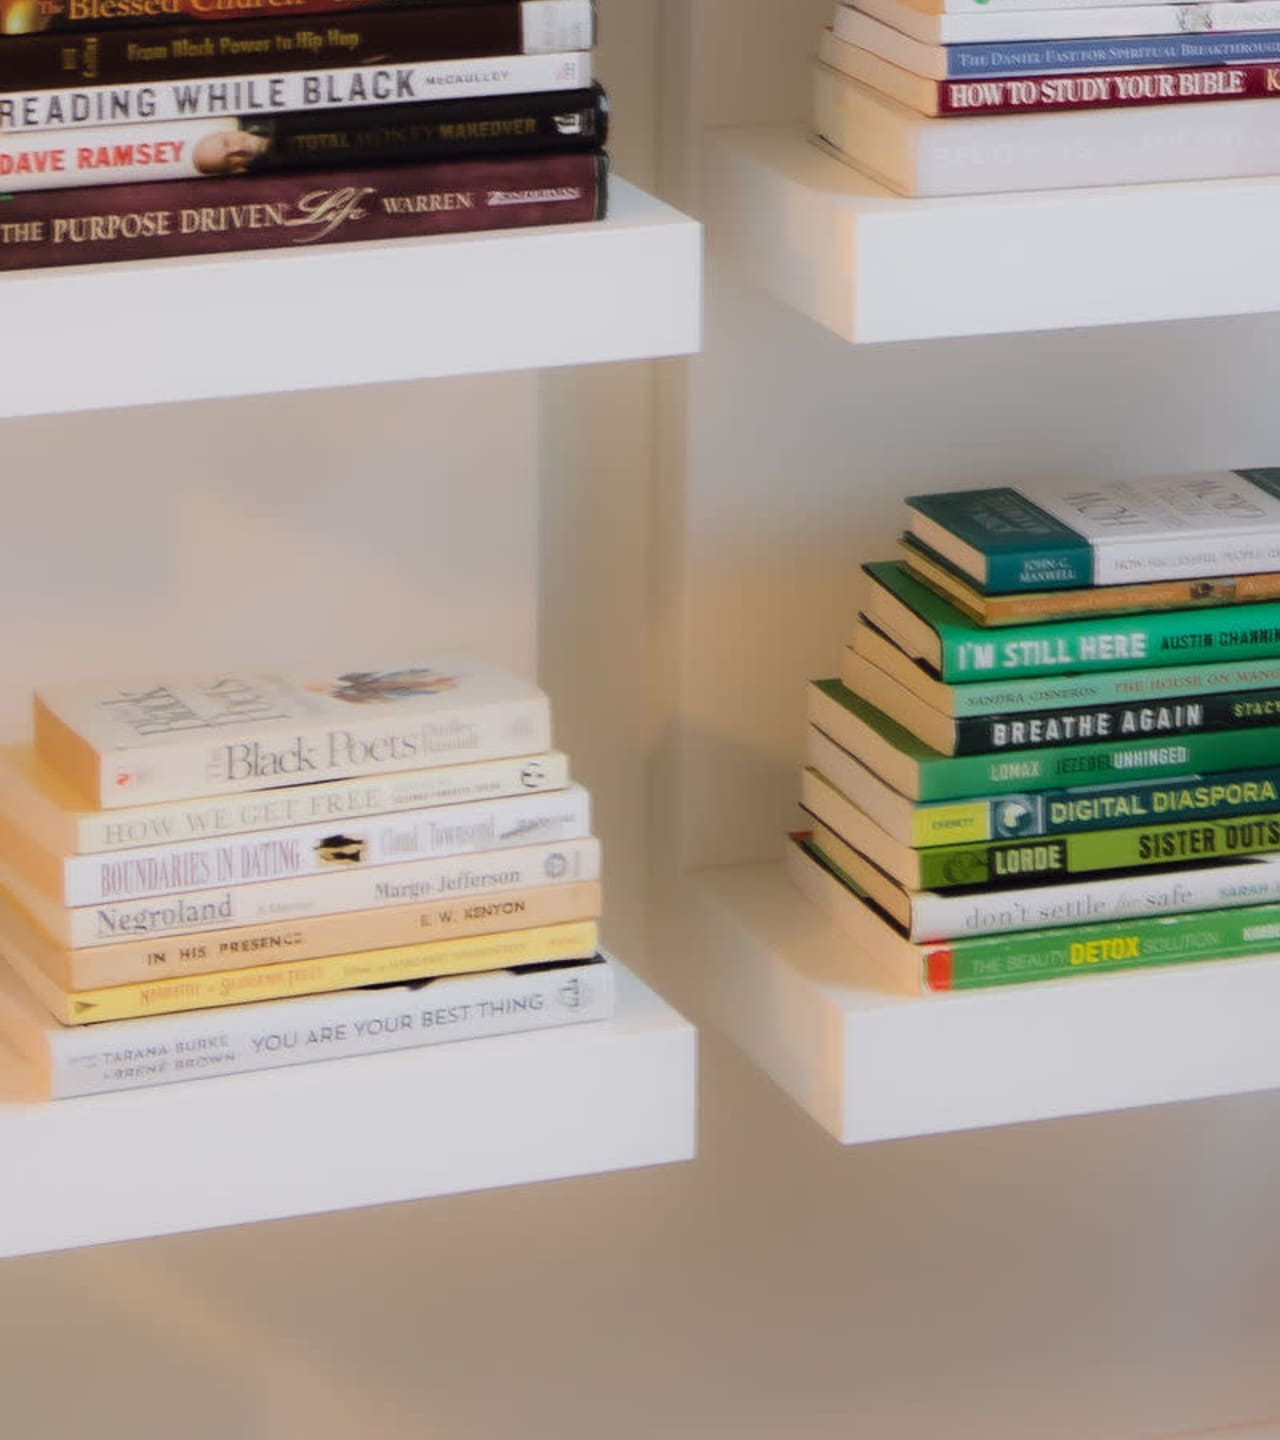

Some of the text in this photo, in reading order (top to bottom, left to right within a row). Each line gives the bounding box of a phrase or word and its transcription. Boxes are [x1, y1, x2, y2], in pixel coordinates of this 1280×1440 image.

[0, 69, 416, 128] READING WHILE BLACK
[950, 70, 1245, 108] HOW TO STUDY YOUR BIBLE
[0, 141, 185, 175] DAVE RAMSEY
[1, 186, 377, 244] THE PURPOSE DRIVEN Life
[381, 191, 474, 215] WARREN
[958, 633, 1147, 670] I'M STILL HERE
[1161, 633, 1213, 651] AUSTIN
[993, 703, 1204, 746] BREATHE AGAIN
[224, 729, 417, 780] Black Poets
[104, 817, 172, 845] HOW
[186, 809, 228, 827] WE
[240, 800, 295, 824] GET
[310, 789, 381, 816] FREE
[1051, 781, 1277, 824] DIGITAL DIASPORA
[994, 845, 1062, 875] LORDE
[1139, 827, 1215, 860] SISTER
[100, 839, 302, 898] BOUNDARIES IN DATING
[374, 868, 521, 901] Margo Jefferson
[964, 902, 1030, 929] don't
[1039, 894, 1107, 921] settle
[1145, 882, 1193, 909] safe
[1218, 883, 1269, 899] SARAH
[97, 893, 232, 934] Negroland
[147, 932, 304, 967] IN HIS PRESENCE
[251, 993, 545, 1054] YOU ARE YOUR BEST THING
